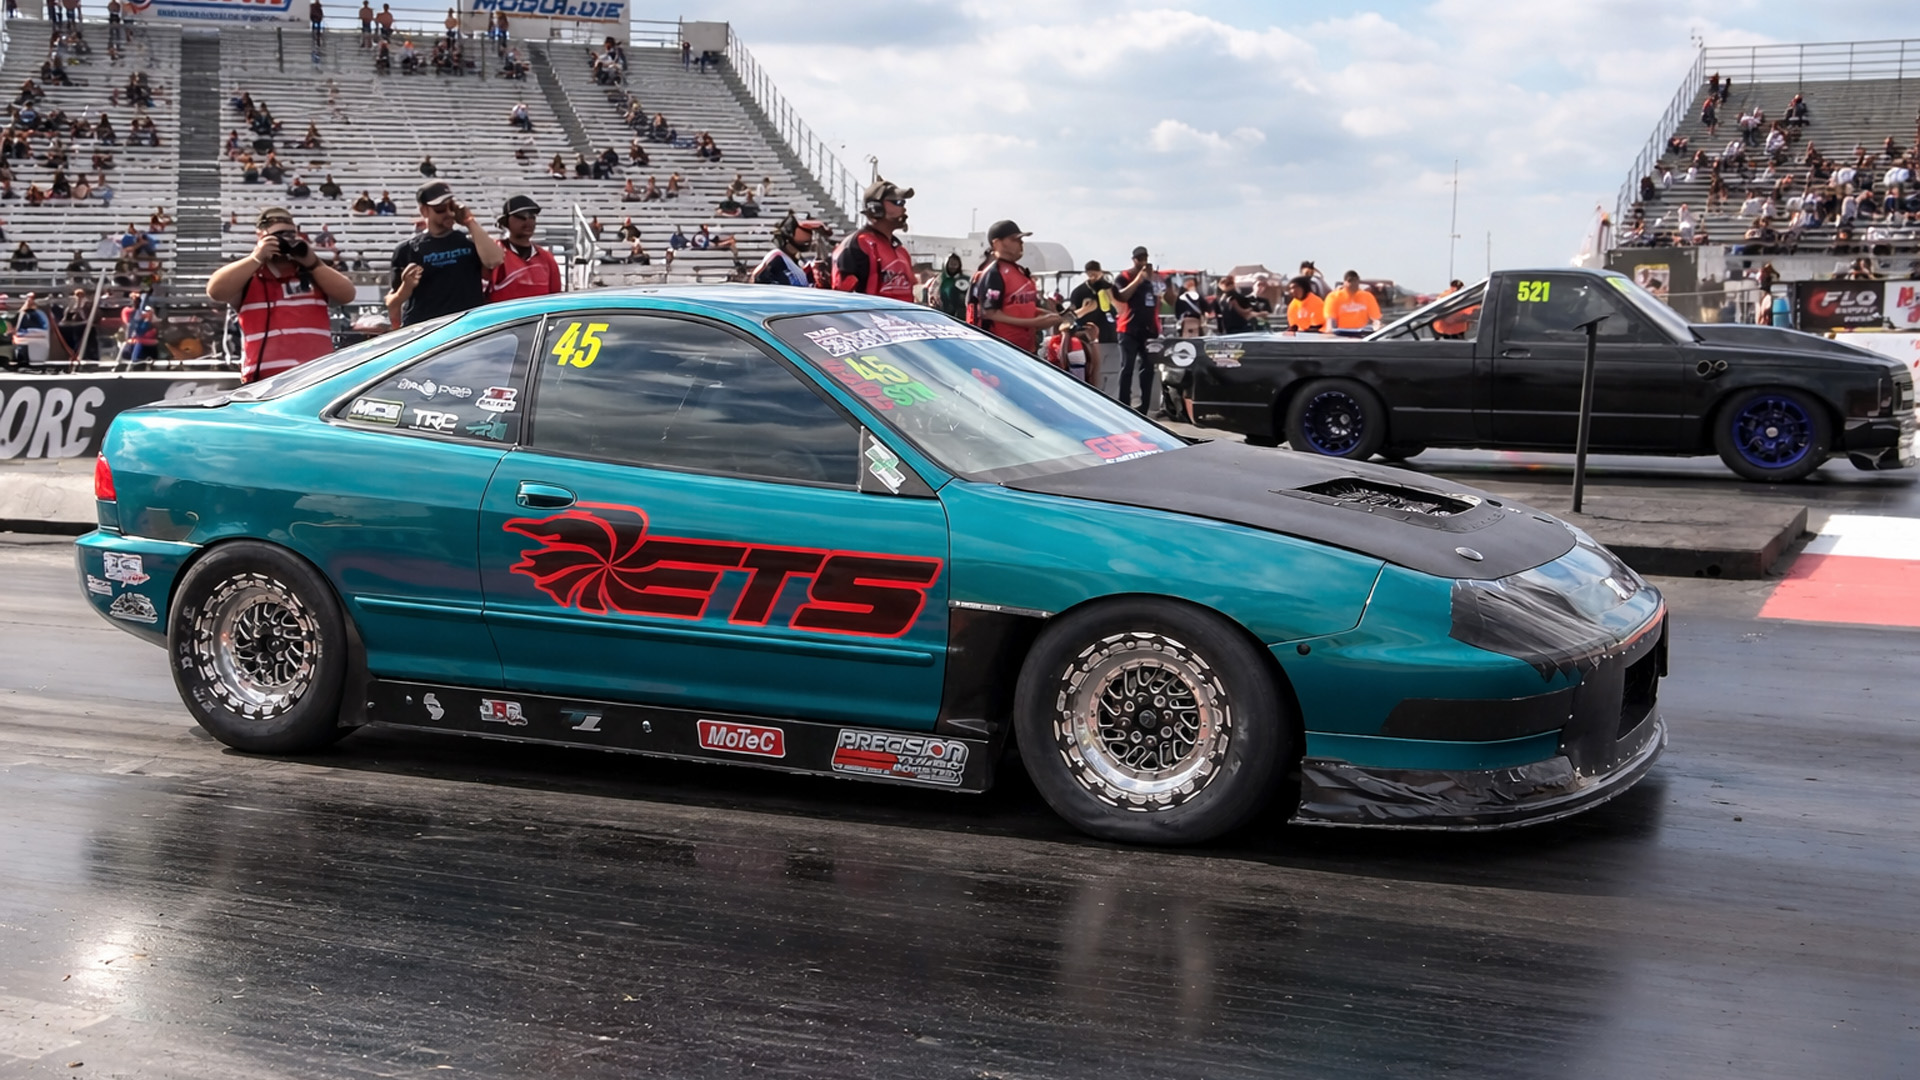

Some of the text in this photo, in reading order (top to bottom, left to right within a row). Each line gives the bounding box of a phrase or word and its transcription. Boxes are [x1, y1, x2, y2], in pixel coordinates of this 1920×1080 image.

[1518, 281, 1550, 302] 521
[1821, 290, 1877, 307] FLO
[552, 322, 610, 368] 45
[845, 355, 910, 385] 45
[0, 386, 105, 459] ORE
[707, 725, 776, 752] MoTeC
[839, 731, 966, 762] PRECISION
